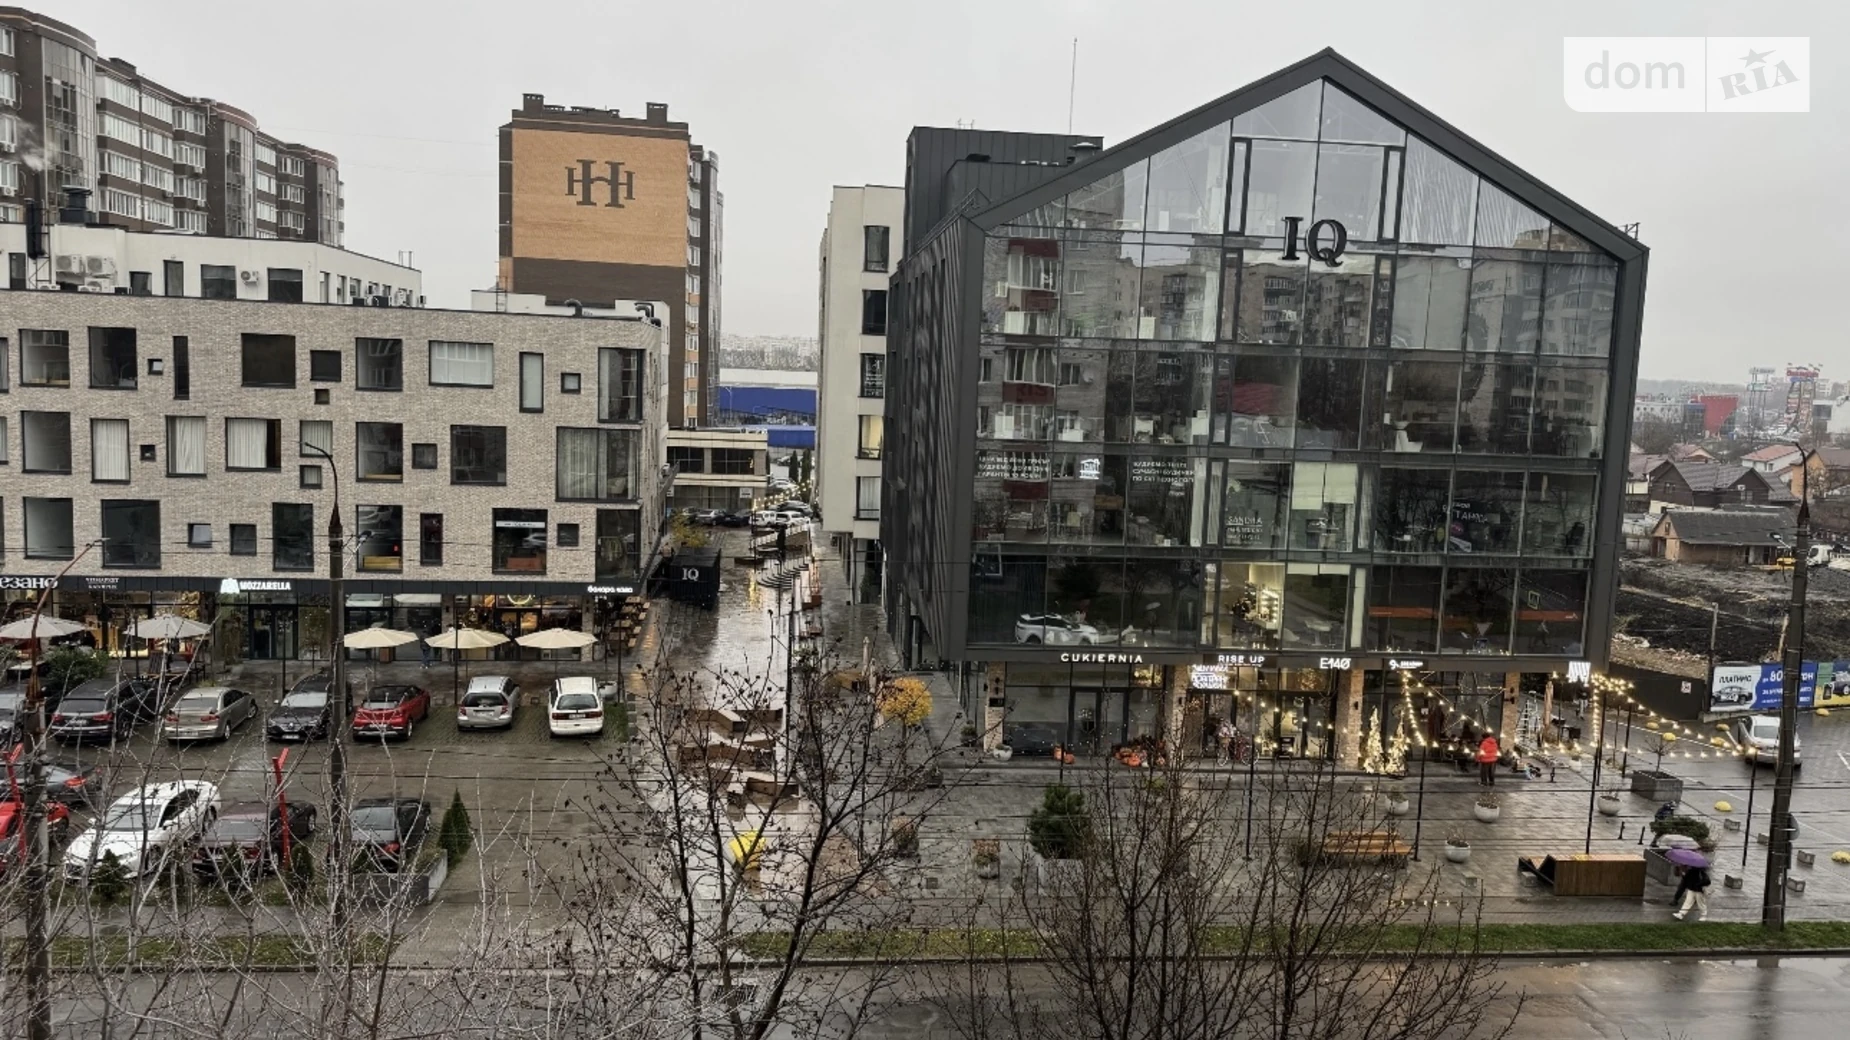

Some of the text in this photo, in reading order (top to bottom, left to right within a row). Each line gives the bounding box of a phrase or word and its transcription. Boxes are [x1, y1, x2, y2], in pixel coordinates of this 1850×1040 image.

[1280, 215, 1347, 268] IQ
[682, 567, 699, 581] IQ
[240, 581, 291, 590] MOZZARELLA
[1060, 653, 1143, 663] CUKIERNIA
[1218, 654, 1265, 664] RISE UP
